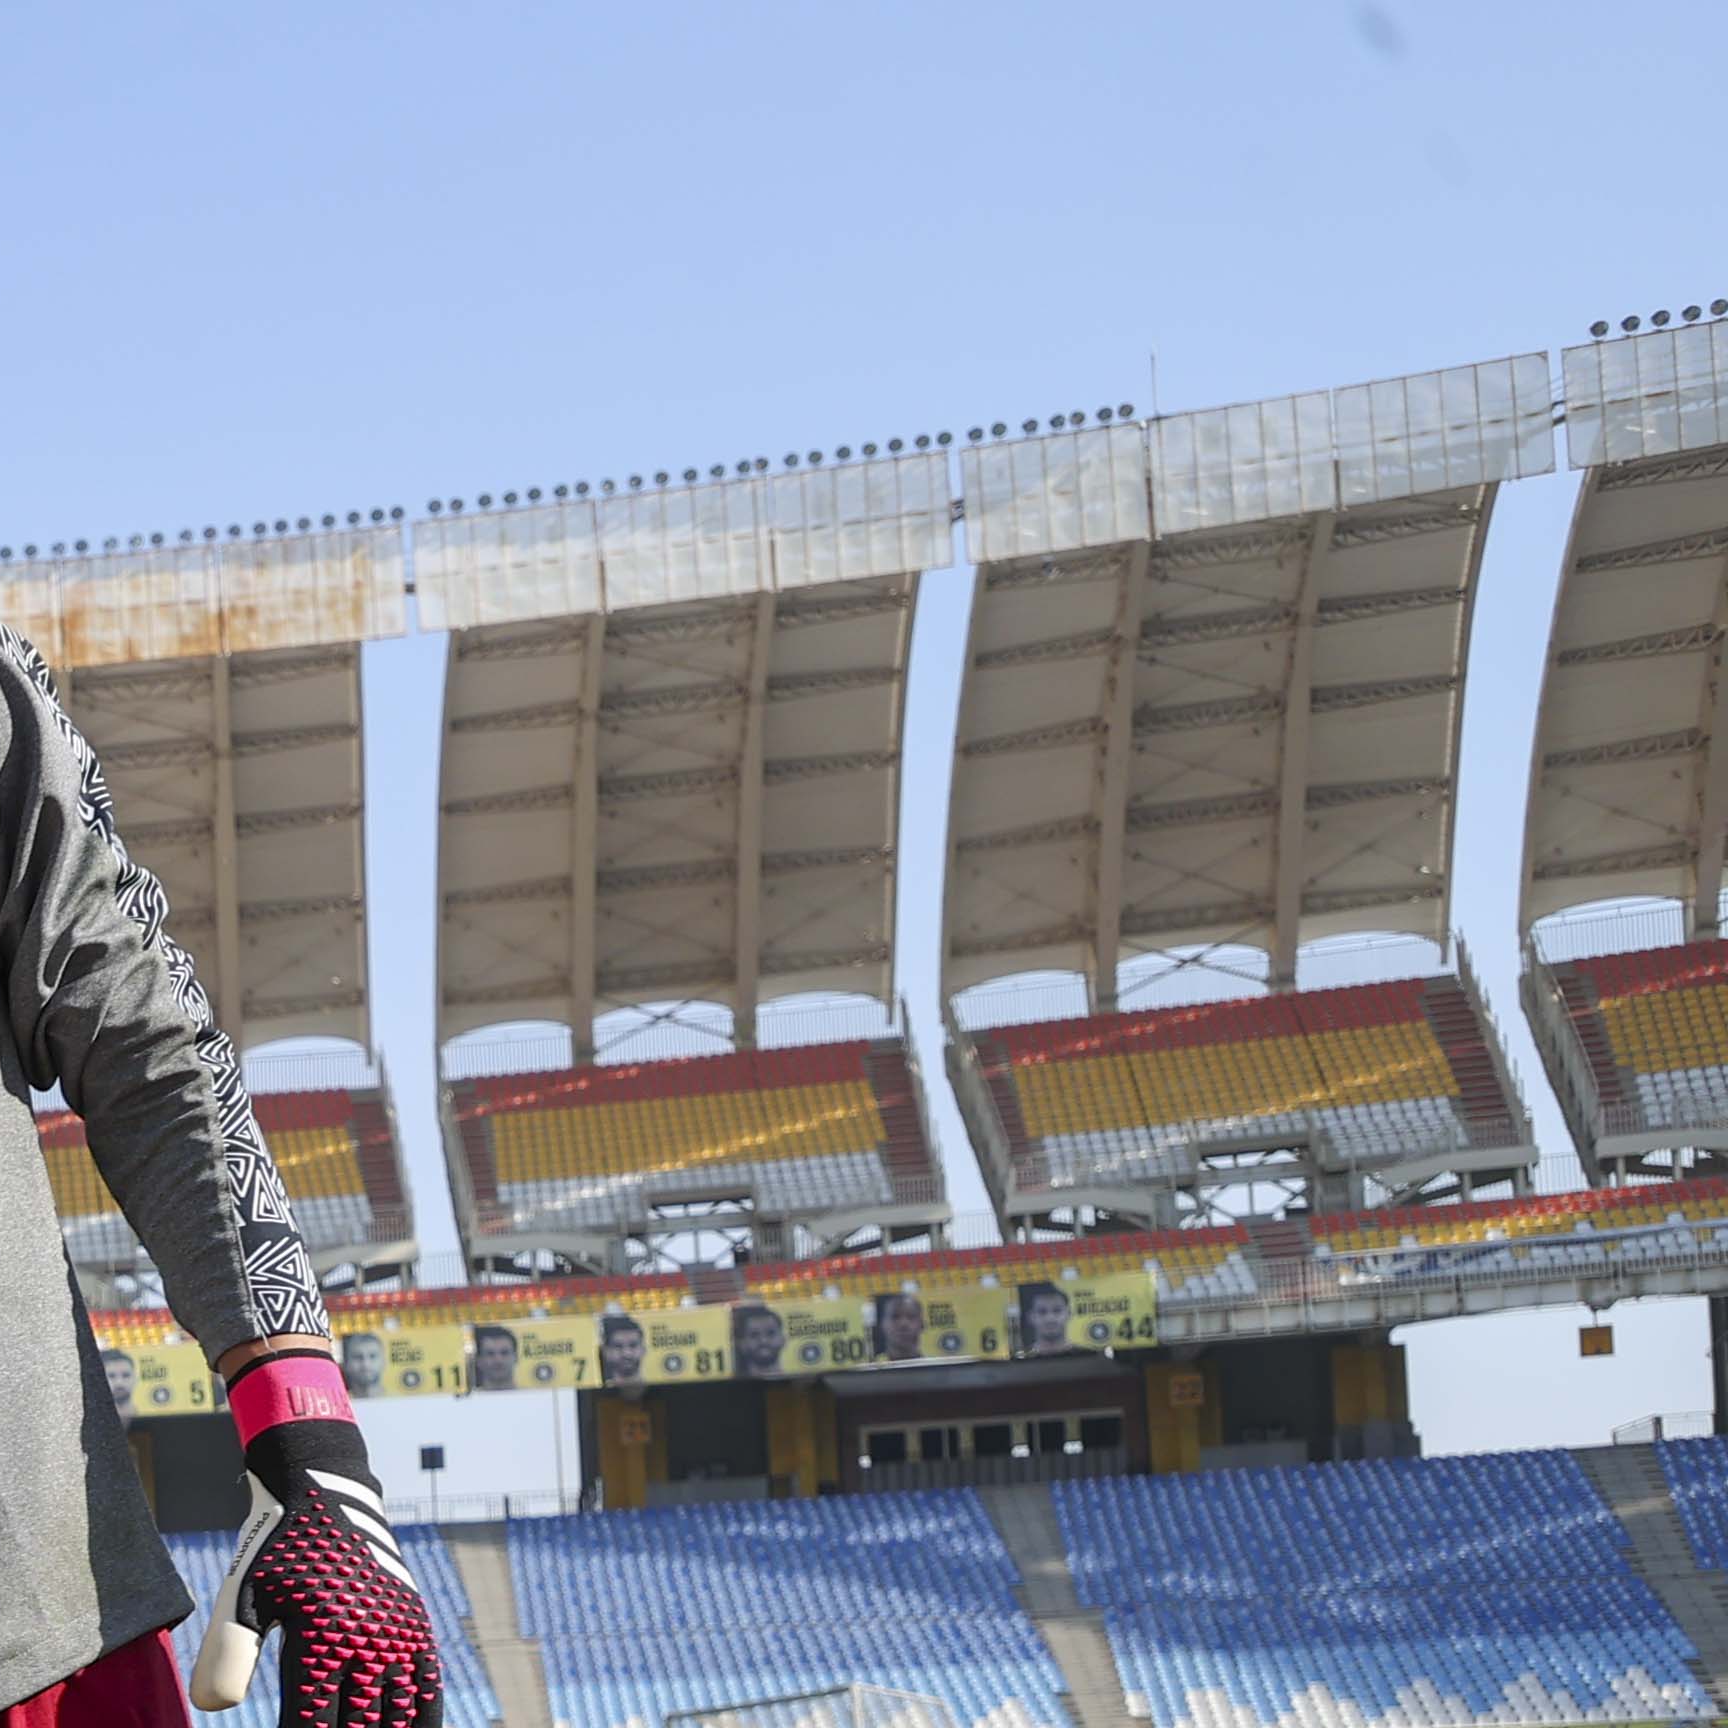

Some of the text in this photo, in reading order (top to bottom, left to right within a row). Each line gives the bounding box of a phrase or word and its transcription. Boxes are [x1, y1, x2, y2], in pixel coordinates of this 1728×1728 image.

[980, 1327, 998, 1352] 6
[1116, 1315, 1154, 1341] 44
[695, 1349, 726, 1374] 81
[830, 1337, 865, 1363] 80
[431, 1364, 463, 1389] 11
[572, 1357, 587, 1382] 7
[190, 1380, 206, 1405] 5
